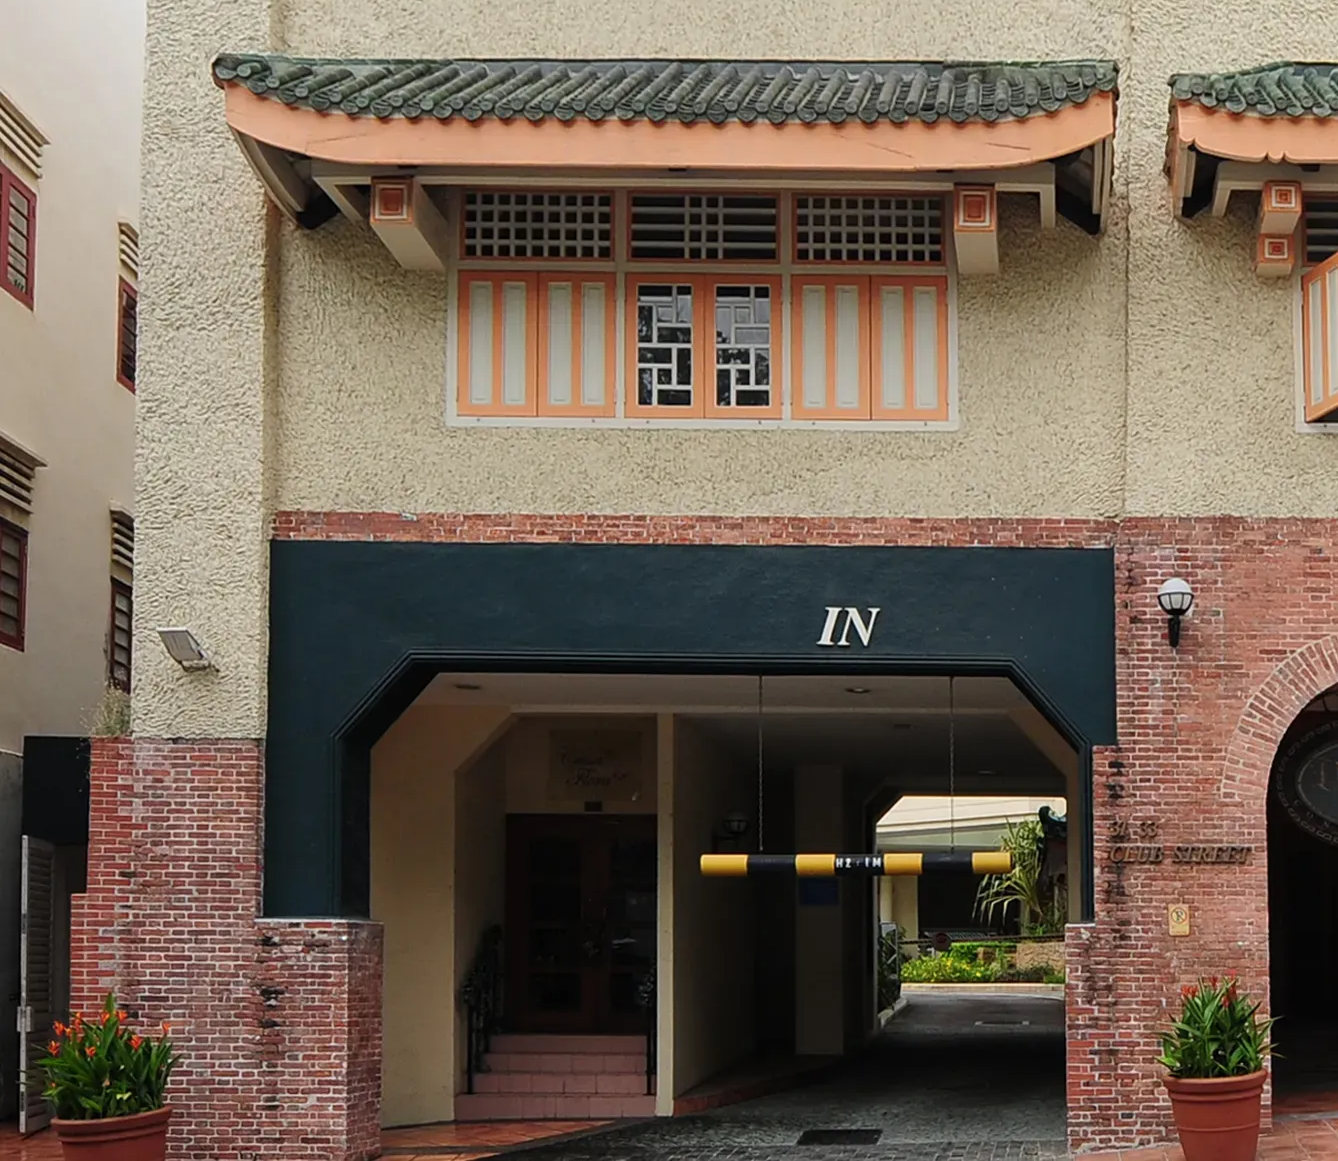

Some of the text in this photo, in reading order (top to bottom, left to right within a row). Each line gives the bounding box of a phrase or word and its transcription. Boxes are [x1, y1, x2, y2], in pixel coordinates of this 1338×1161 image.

[816, 605, 881, 647] IN
[1110, 845, 1253, 865] CLUB STREET
